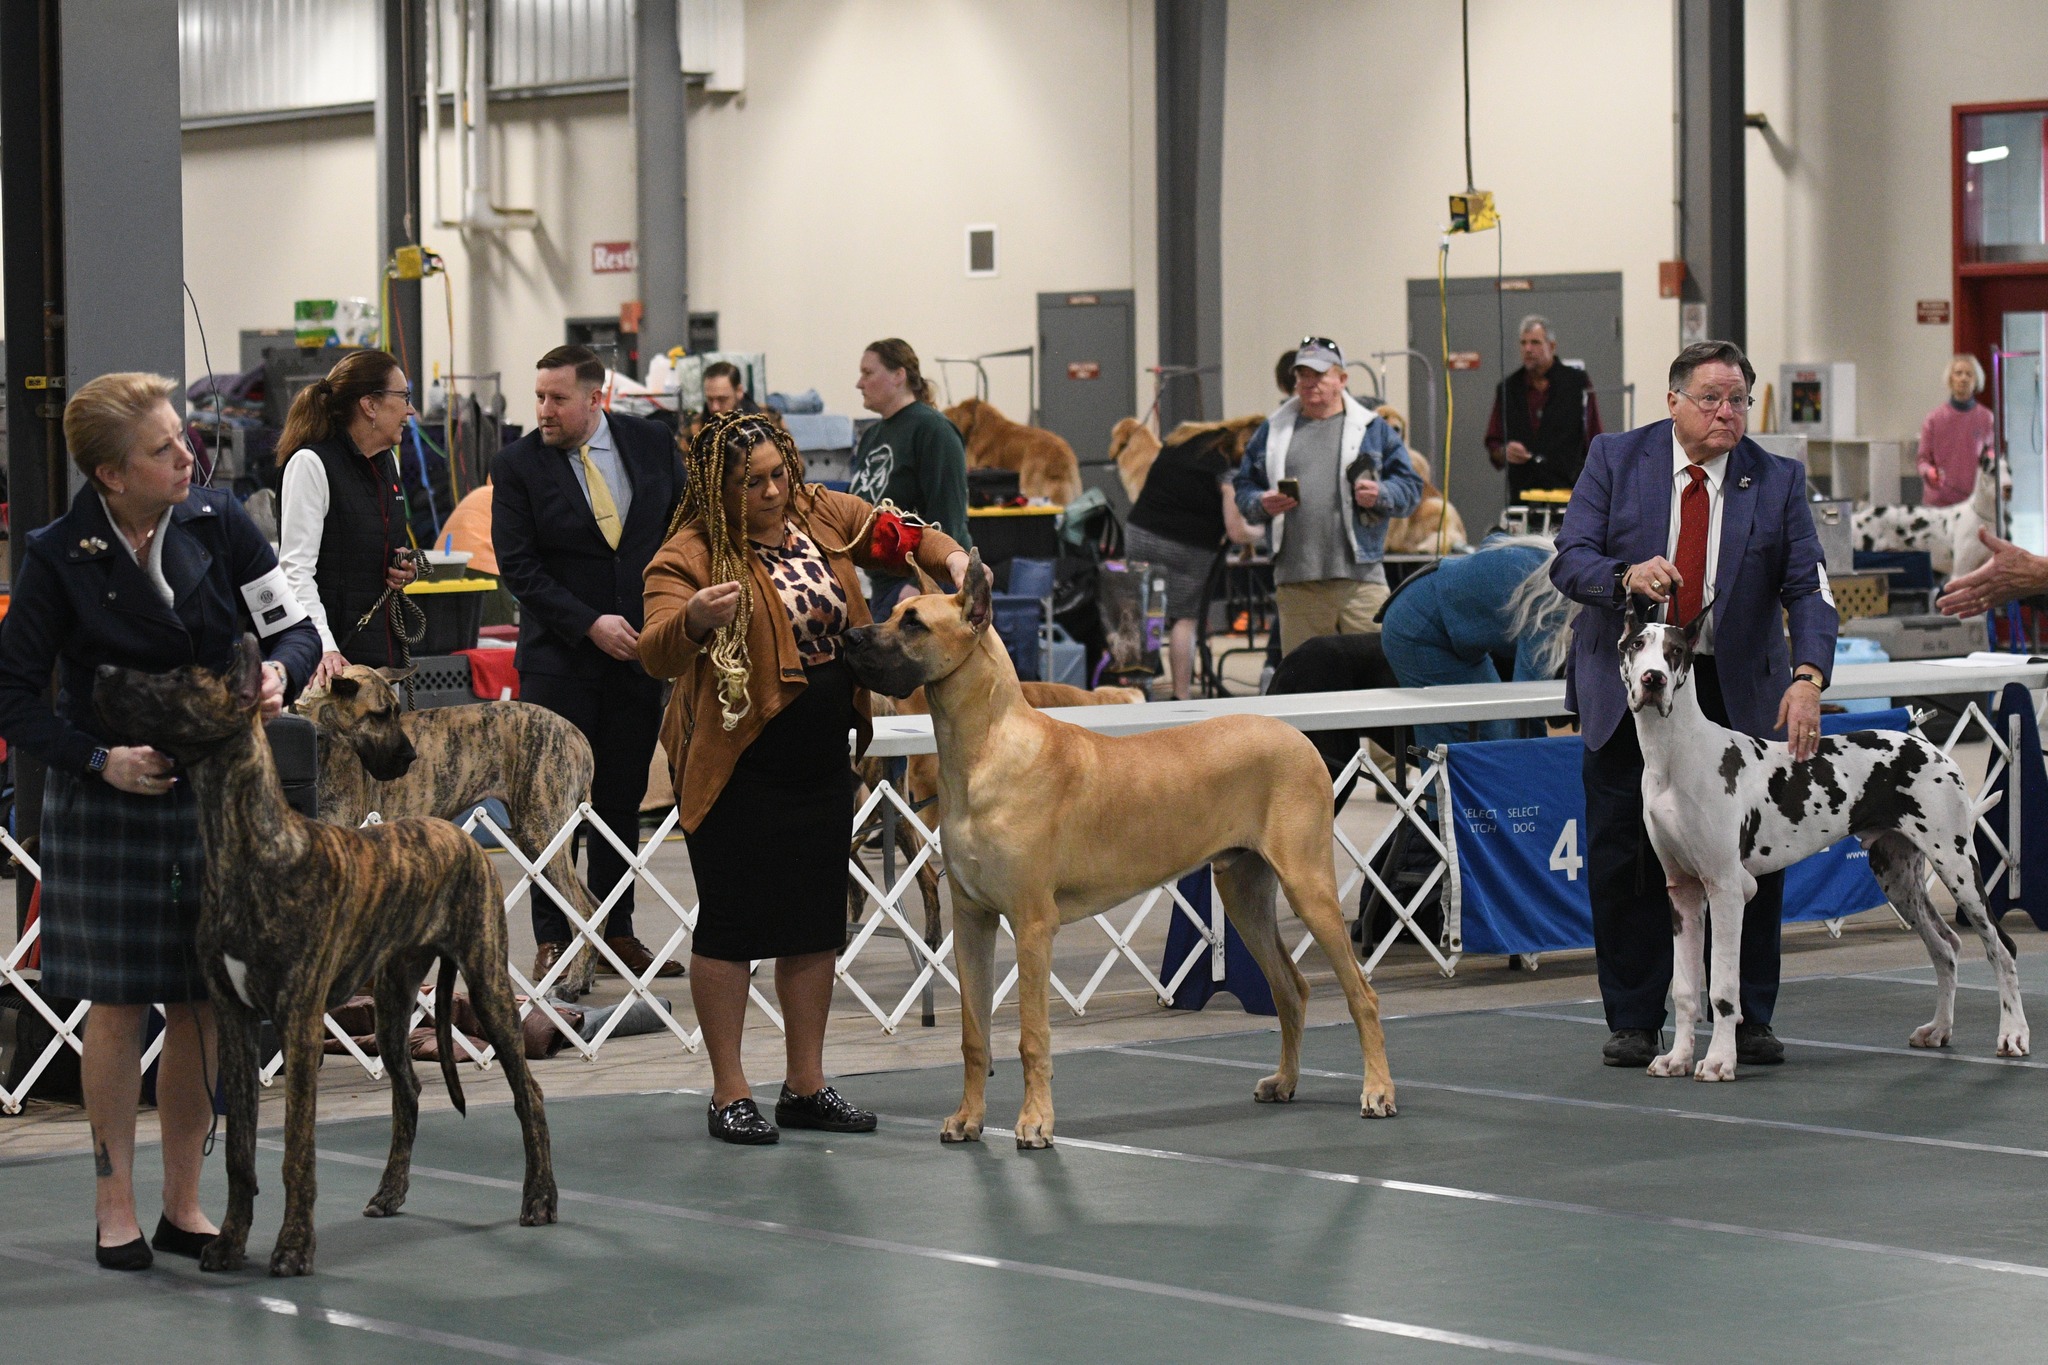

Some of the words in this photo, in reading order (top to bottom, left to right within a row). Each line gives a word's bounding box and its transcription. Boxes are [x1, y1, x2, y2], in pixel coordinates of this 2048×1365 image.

[1463, 808, 1498, 819] SELECT
[1507, 806, 1540, 818] SELECT
[1512, 822, 1536, 834] DOG
[1549, 818, 1583, 881] 4
[1845, 850, 1868, 860] www
